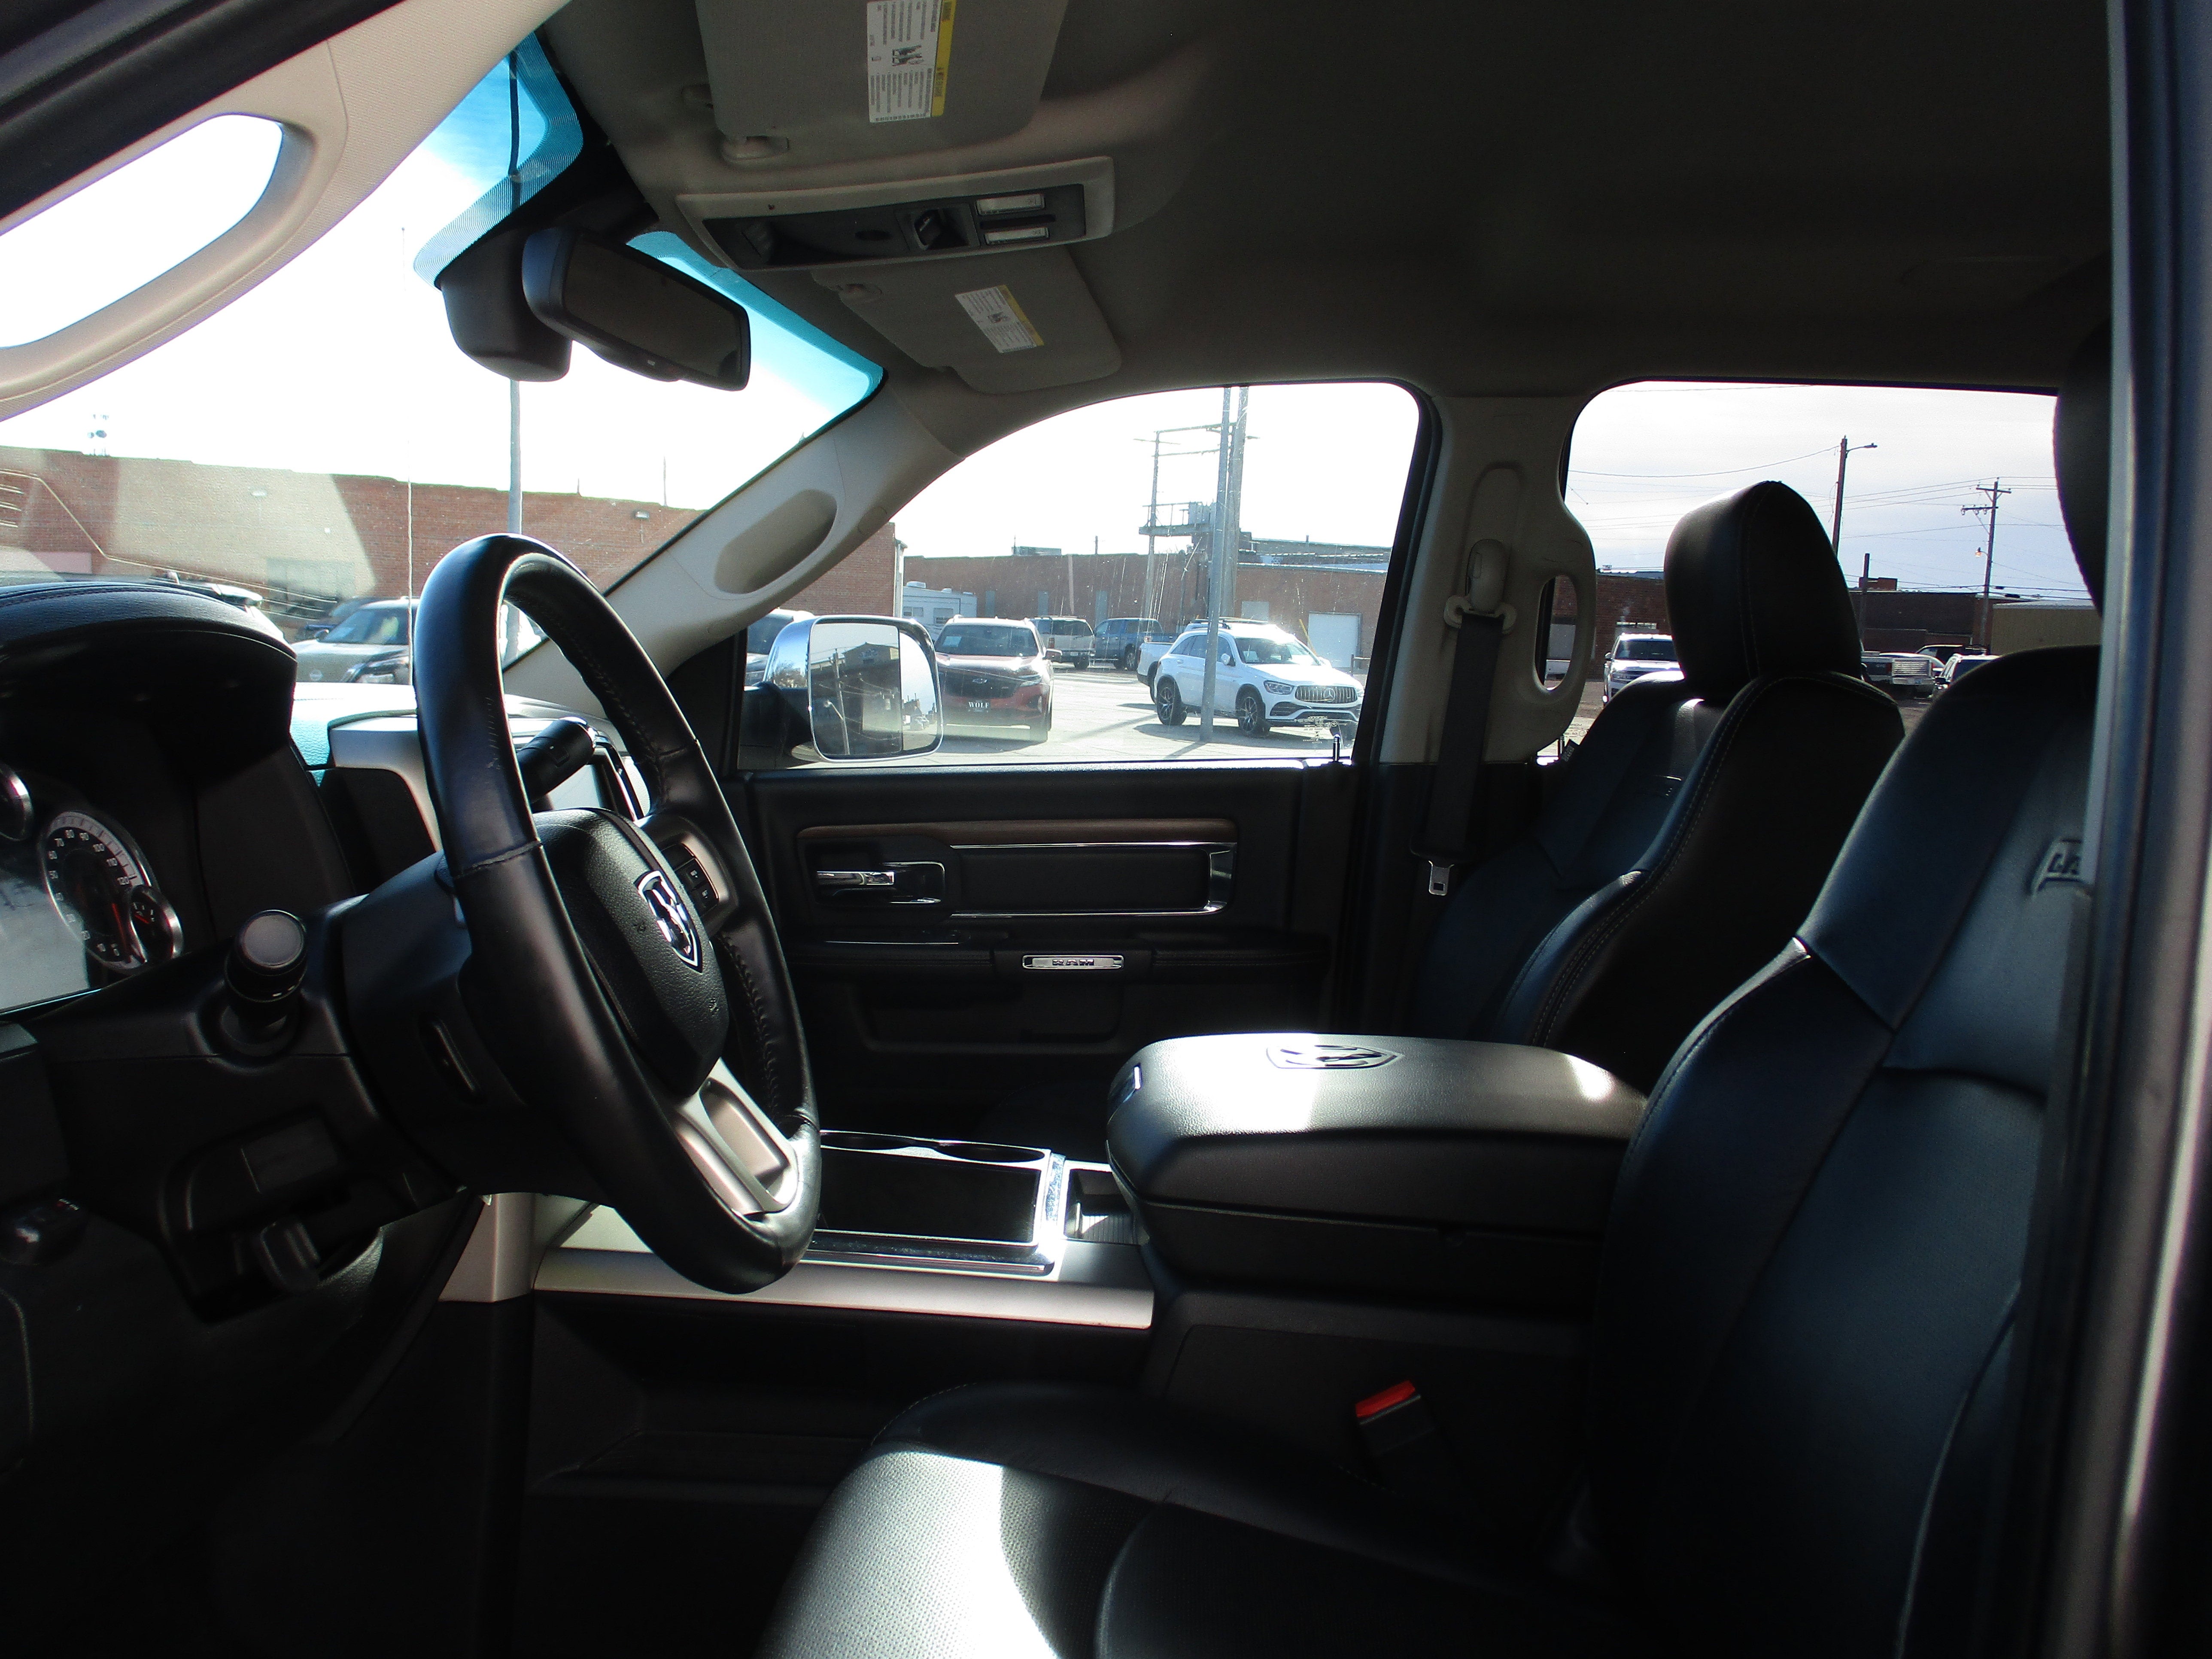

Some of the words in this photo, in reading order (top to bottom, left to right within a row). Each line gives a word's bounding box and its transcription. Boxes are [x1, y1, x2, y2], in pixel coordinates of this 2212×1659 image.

[80, 832, 89, 841] 90
[54, 838, 65, 847] 70
[92, 843, 105, 852] 100
[106, 857, 118, 867] 110
[117, 876, 130, 885] 120
